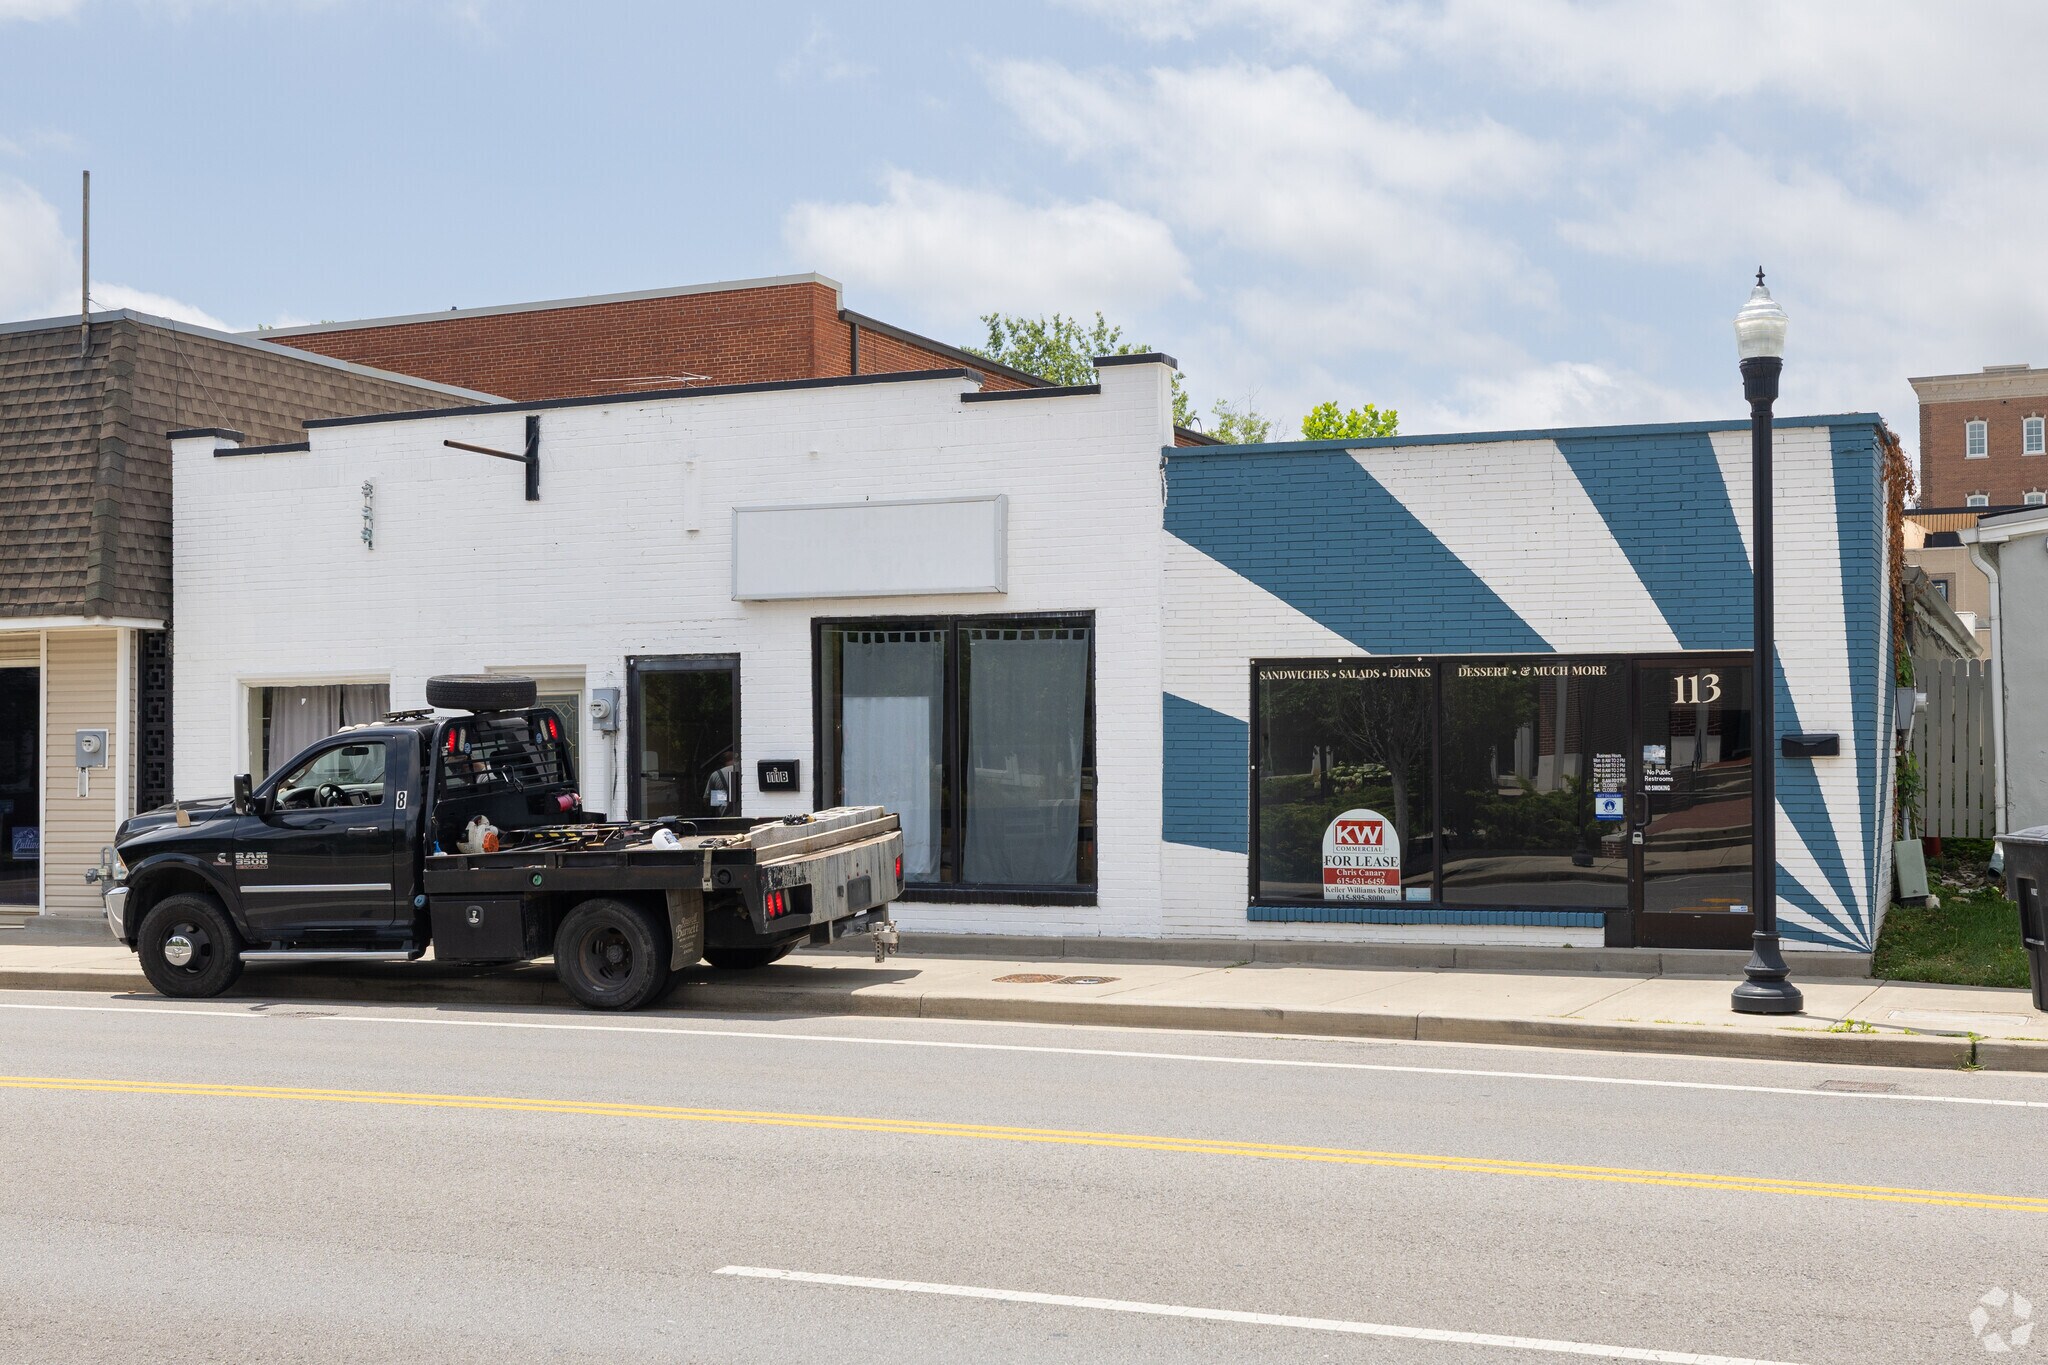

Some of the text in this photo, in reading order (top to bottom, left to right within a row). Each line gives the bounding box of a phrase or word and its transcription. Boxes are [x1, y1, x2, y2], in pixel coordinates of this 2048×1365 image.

[1259, 668, 1431, 680] SANDWICHES SALADS DRINKS
[1458, 665, 1607, 677] DESSERT & MUCH MORE
[1673, 673, 1721, 704] 113
[766, 771, 788, 783] 111B
[397, 791, 406, 809] 8
[1336, 825, 1382, 844] KW
[1325, 855, 1399, 867] FOR LEASE
[1358, 869, 1386, 878] Canary
[1336, 877, 1385, 885] 615-631-6459
[1347, 886, 1377, 894] Williams
[1378, 887, 1399, 896] Realty
